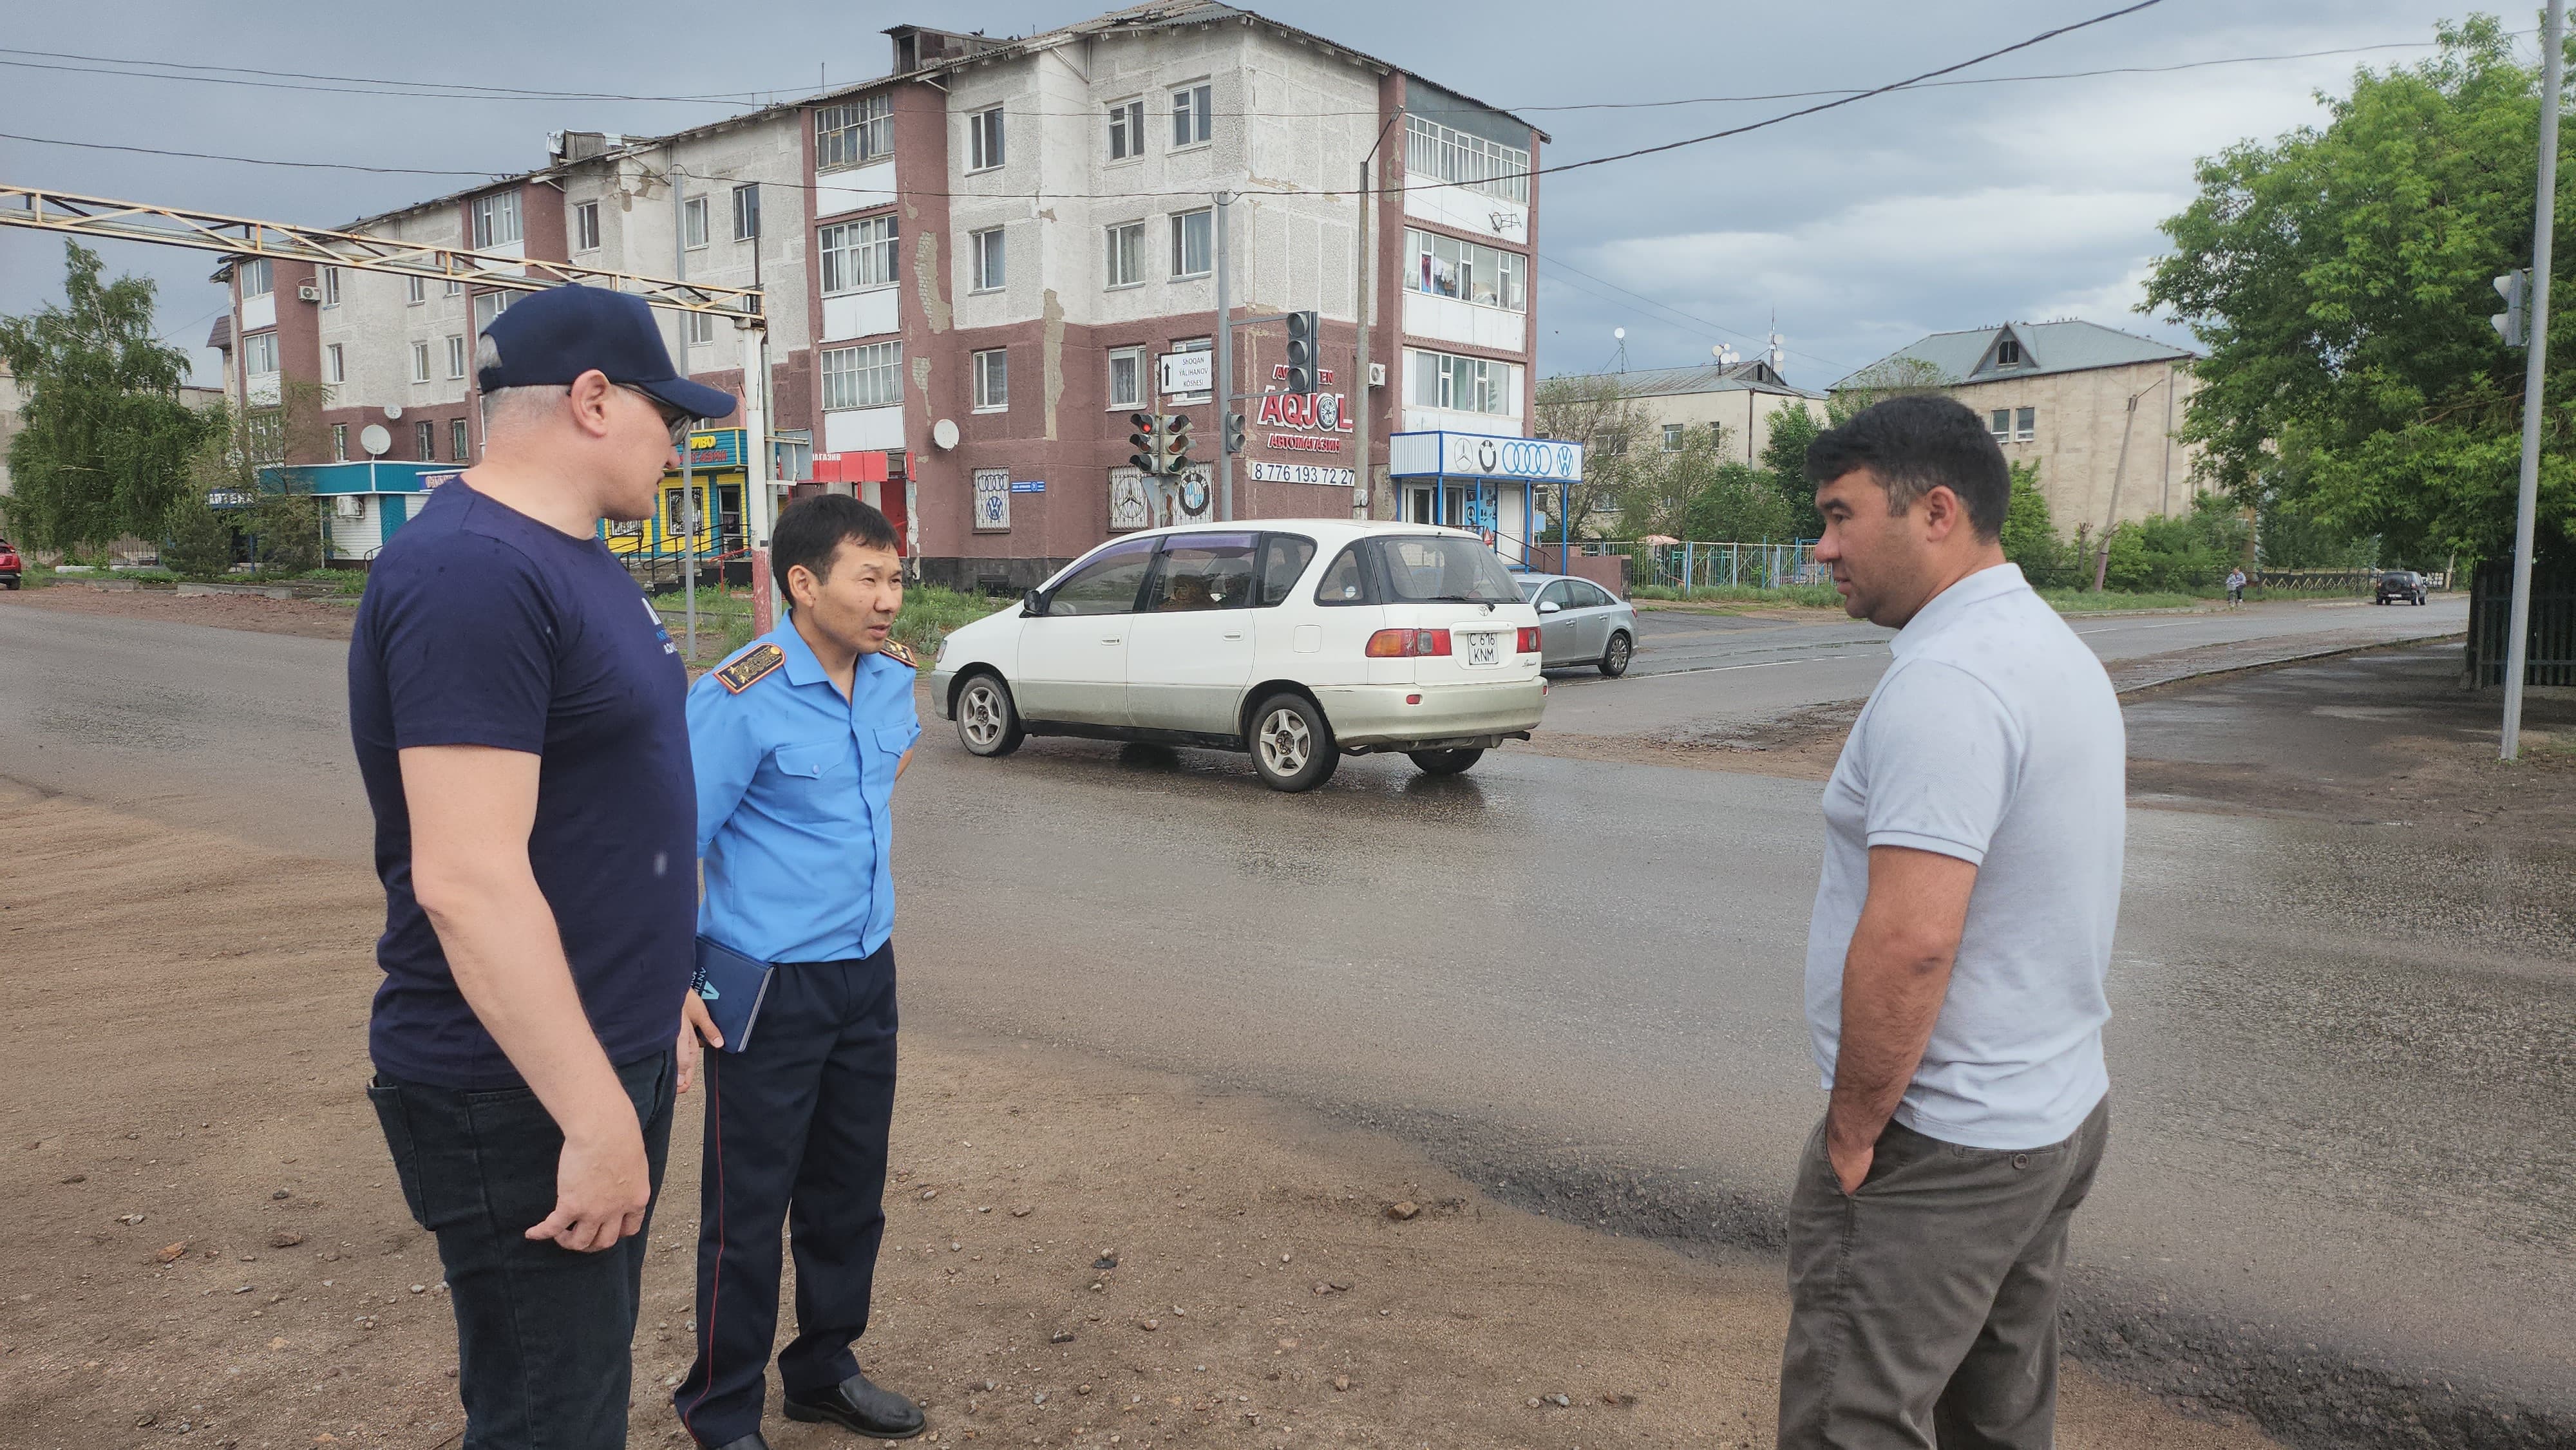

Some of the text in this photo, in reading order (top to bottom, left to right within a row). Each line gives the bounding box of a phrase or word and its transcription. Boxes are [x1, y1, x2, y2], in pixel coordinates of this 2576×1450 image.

[1268, 433, 1340, 452] АВТОМАГАЗИН
[1255, 464, 1355, 484] 8 776 193 72 27
[1470, 634, 1495, 646] C 616
[1474, 648, 1494, 662] KNM
